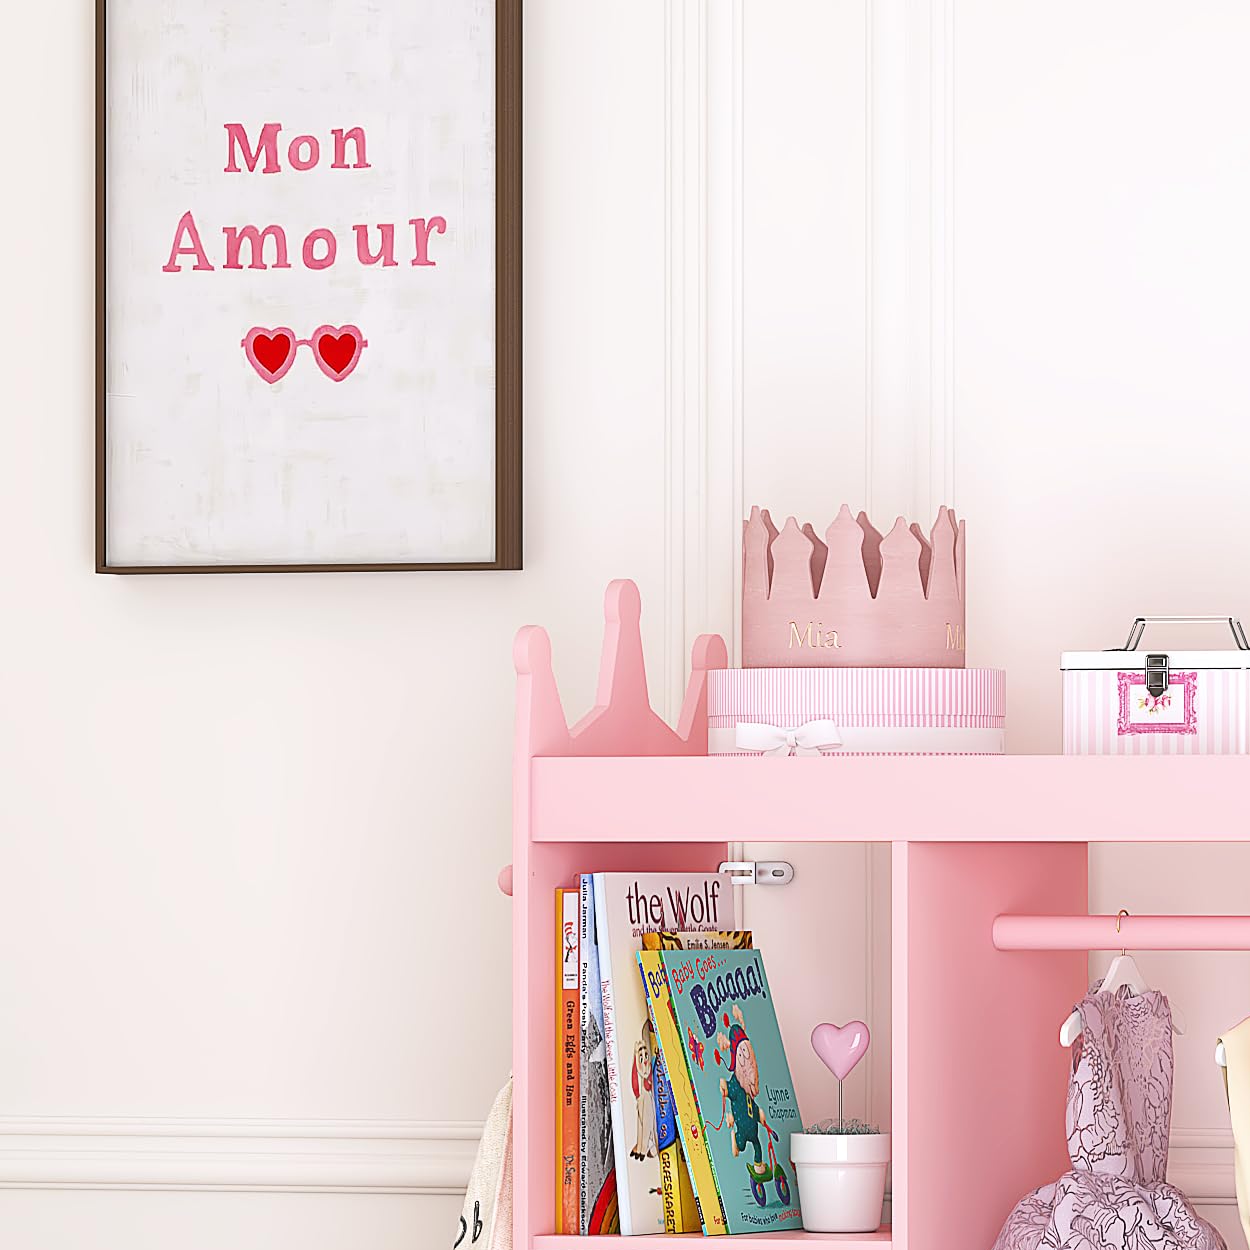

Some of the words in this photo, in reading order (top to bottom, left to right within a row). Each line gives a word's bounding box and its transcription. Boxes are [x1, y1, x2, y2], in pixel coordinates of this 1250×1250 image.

[223, 122, 372, 174] Mon
[162, 210, 447, 273] Amour
[788, 621, 843, 649] Mia
[625, 881, 662, 925] the
[666, 880, 720, 924] Wolf
[711, 939, 730, 950] Jensen
[671, 960, 695, 995] Baby
[602, 994, 613, 1011] Wolf
[689, 957, 767, 1039] Baaaaa!
[566, 1000, 575, 1030] Green
[603, 1011, 612, 1025] and
[565, 1034, 576, 1059] Eggs
[580, 1029, 588, 1054] Party
[605, 1039, 614, 1062] Seven
[566, 1063, 575, 1081] and
[566, 1084, 575, 1106] Ham
[765, 1084, 790, 1105] Lynne
[768, 1105, 797, 1122] Chapman
[580, 1140, 588, 1154] by
[661, 1152, 676, 1234] GRÆSKARET
